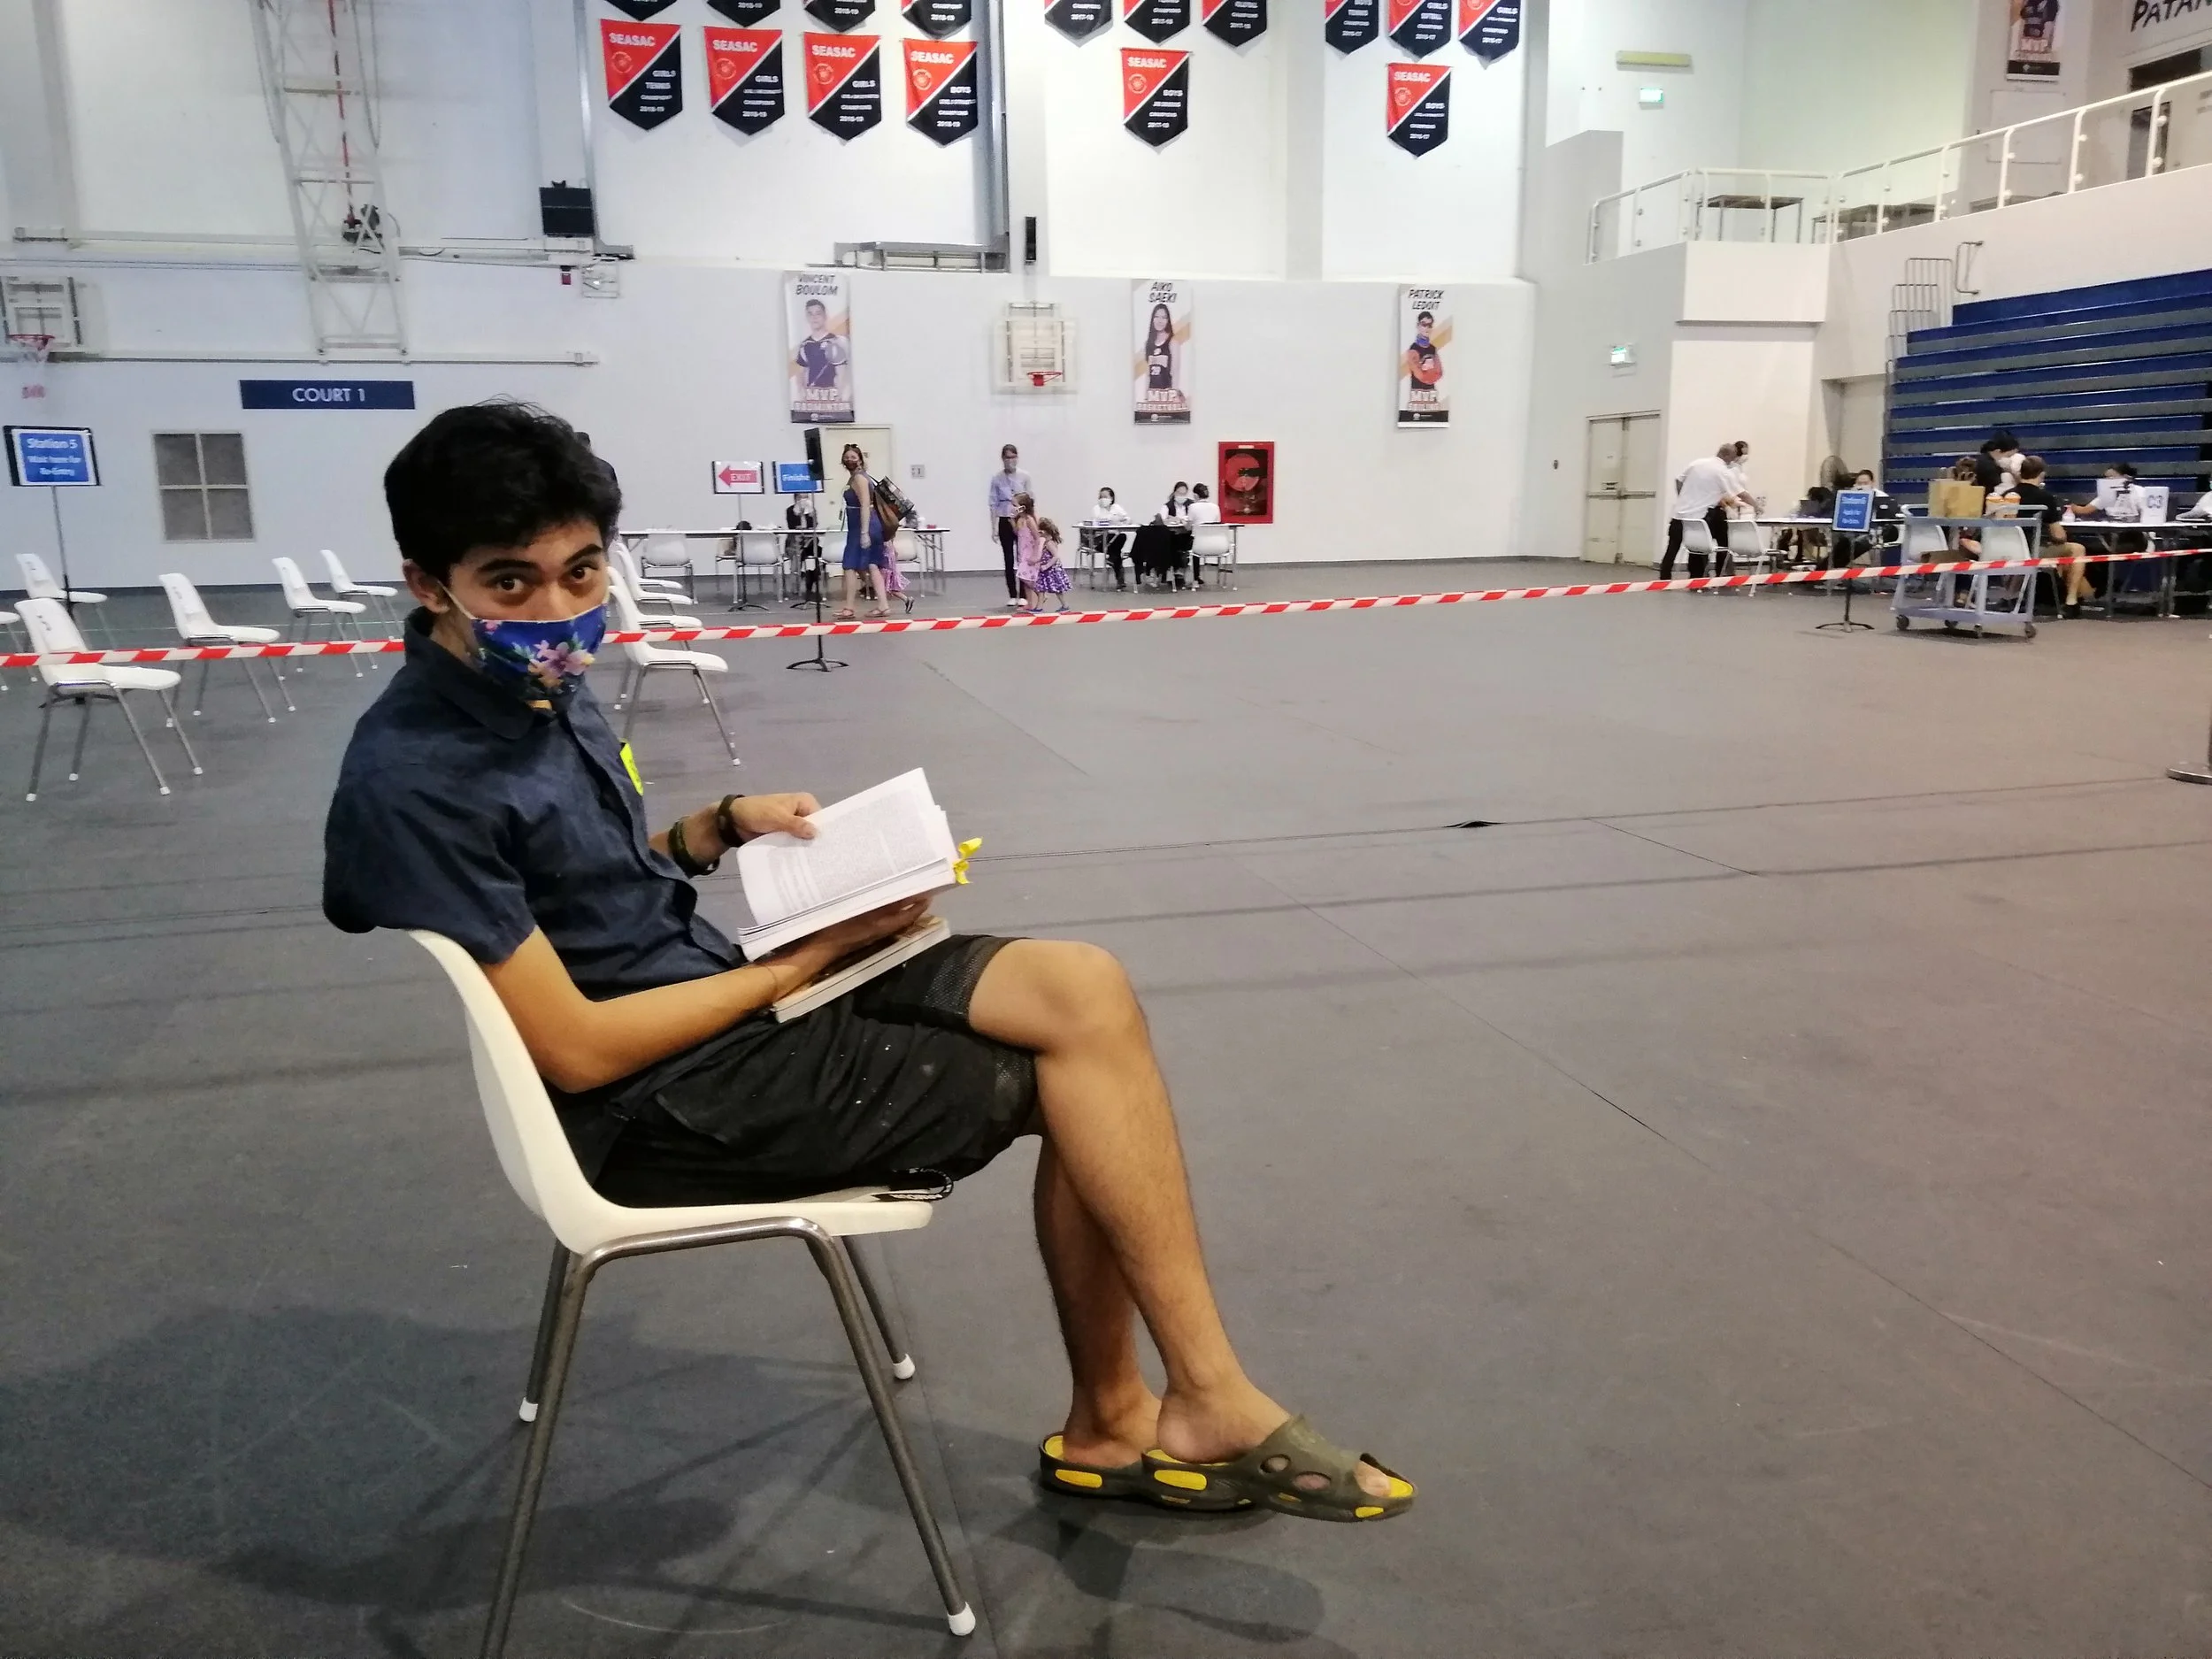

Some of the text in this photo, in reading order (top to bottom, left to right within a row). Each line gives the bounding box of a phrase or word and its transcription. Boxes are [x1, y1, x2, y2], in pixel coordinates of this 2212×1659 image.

[609, 32, 657, 47] SEASAC
[712, 39, 758, 53] SEASAC
[811, 44, 856, 58] SEASAC
[910, 50, 955, 65] SEASAC
[1127, 57, 1167, 68] SEASAC
[1394, 71, 1431, 83] SEASAC
[1409, 289, 1444, 300] PATRICK
[292, 388, 365, 402] COURT 1
[27, 438, 79, 449] Station 5
